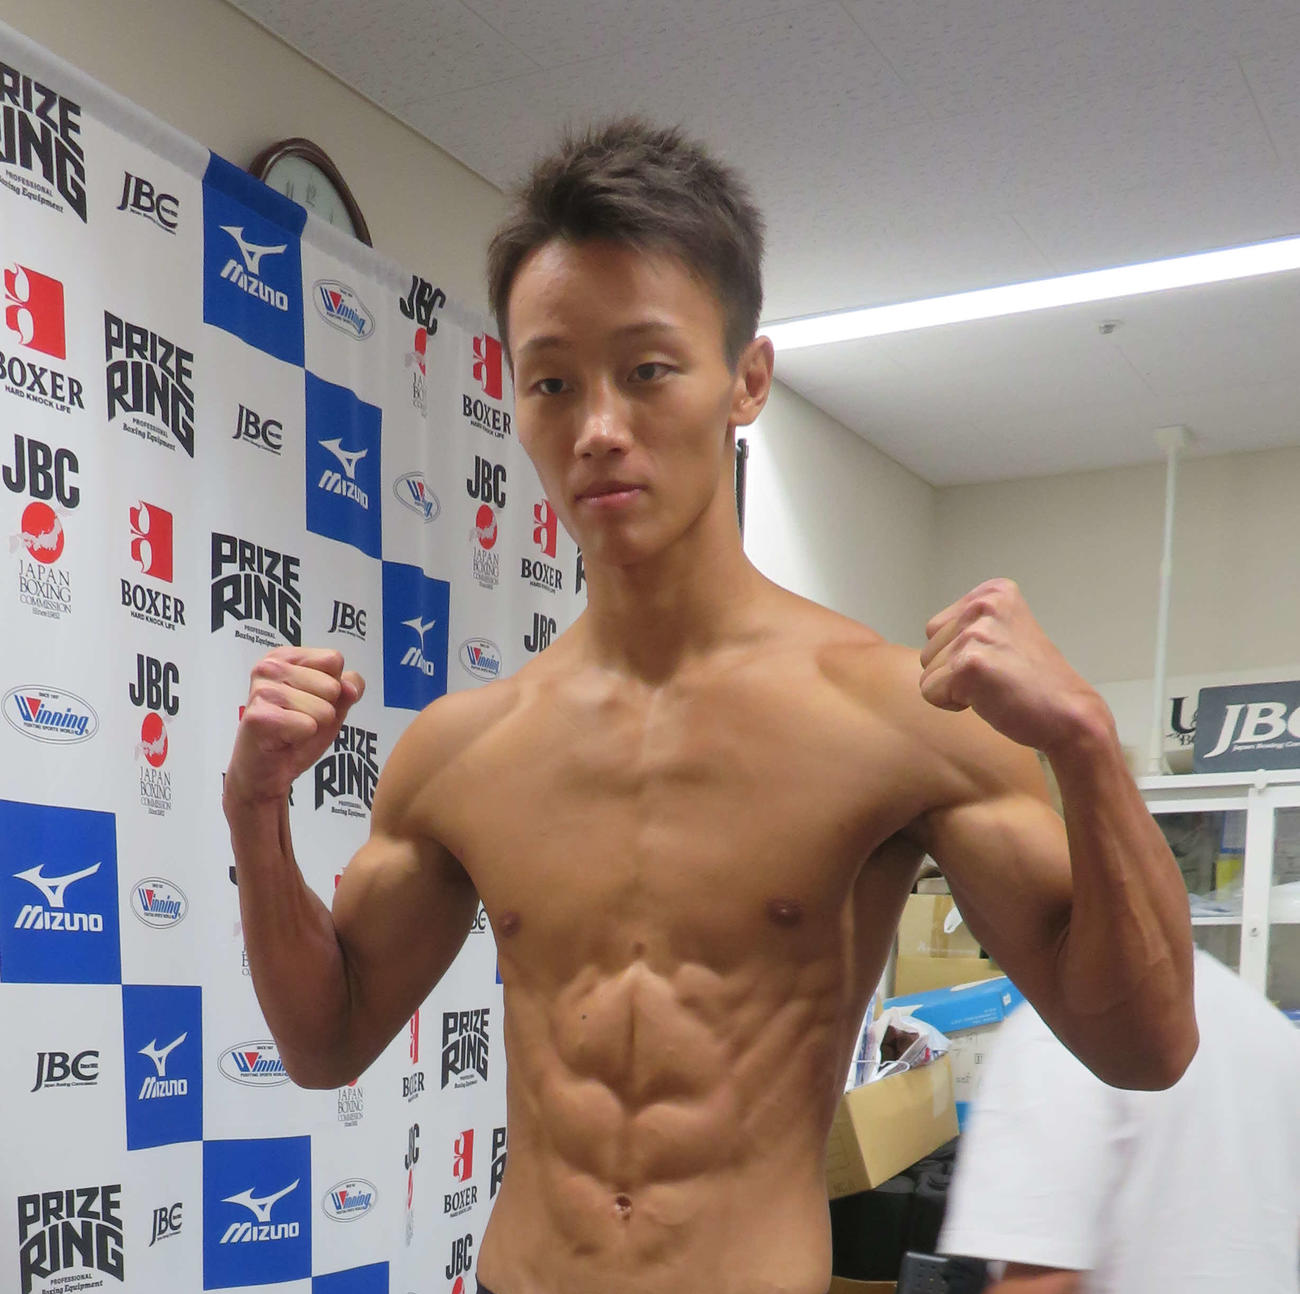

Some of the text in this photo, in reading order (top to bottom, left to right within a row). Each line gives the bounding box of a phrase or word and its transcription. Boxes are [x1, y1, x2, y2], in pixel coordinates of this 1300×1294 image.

[0, 61, 84, 162] RIZE
[0, 104, 88, 224] ING
[6, 169, 54, 198] PROFESSIONAL
[22, 186, 64, 213] Equipment
[400, 275, 446, 336] JBC
[104, 309, 195, 404] PRIZE
[5, 385, 72, 414] HARD KNOCK LIFE
[106, 360, 195, 459] RING
[463, 394, 512, 435] BOXER
[123, 422, 176, 451] Boxing Equipment
[2, 433, 80, 510] JBC
[466, 455, 507, 510] JBC
[19, 559, 70, 587] JAPAN
[19, 576, 71, 603] BOXING
[211, 531, 302, 605] PRIZE
[520, 557, 563, 591] BOXER
[120, 578, 186, 626] BOXER
[211, 573, 302, 648] RING
[234, 630, 255, 644] Boxing
[129, 653, 180, 716] JBC
[14, 694, 89, 736] Winning
[333, 724, 379, 775] RIZE
[314, 753, 380, 811] RING
[442, 1008, 490, 1050] PRIZE
[231, 1051, 287, 1073] Winni
[441, 1033, 488, 1091] RING
[17, 1184, 124, 1247] PRIZE
[444, 1185, 478, 1214] BOXER
[50, 1273, 93, 1286] PROFESSIONAL
[446, 1233, 472, 1280] JBC
[64, 1280, 103, 1293] Equipment
